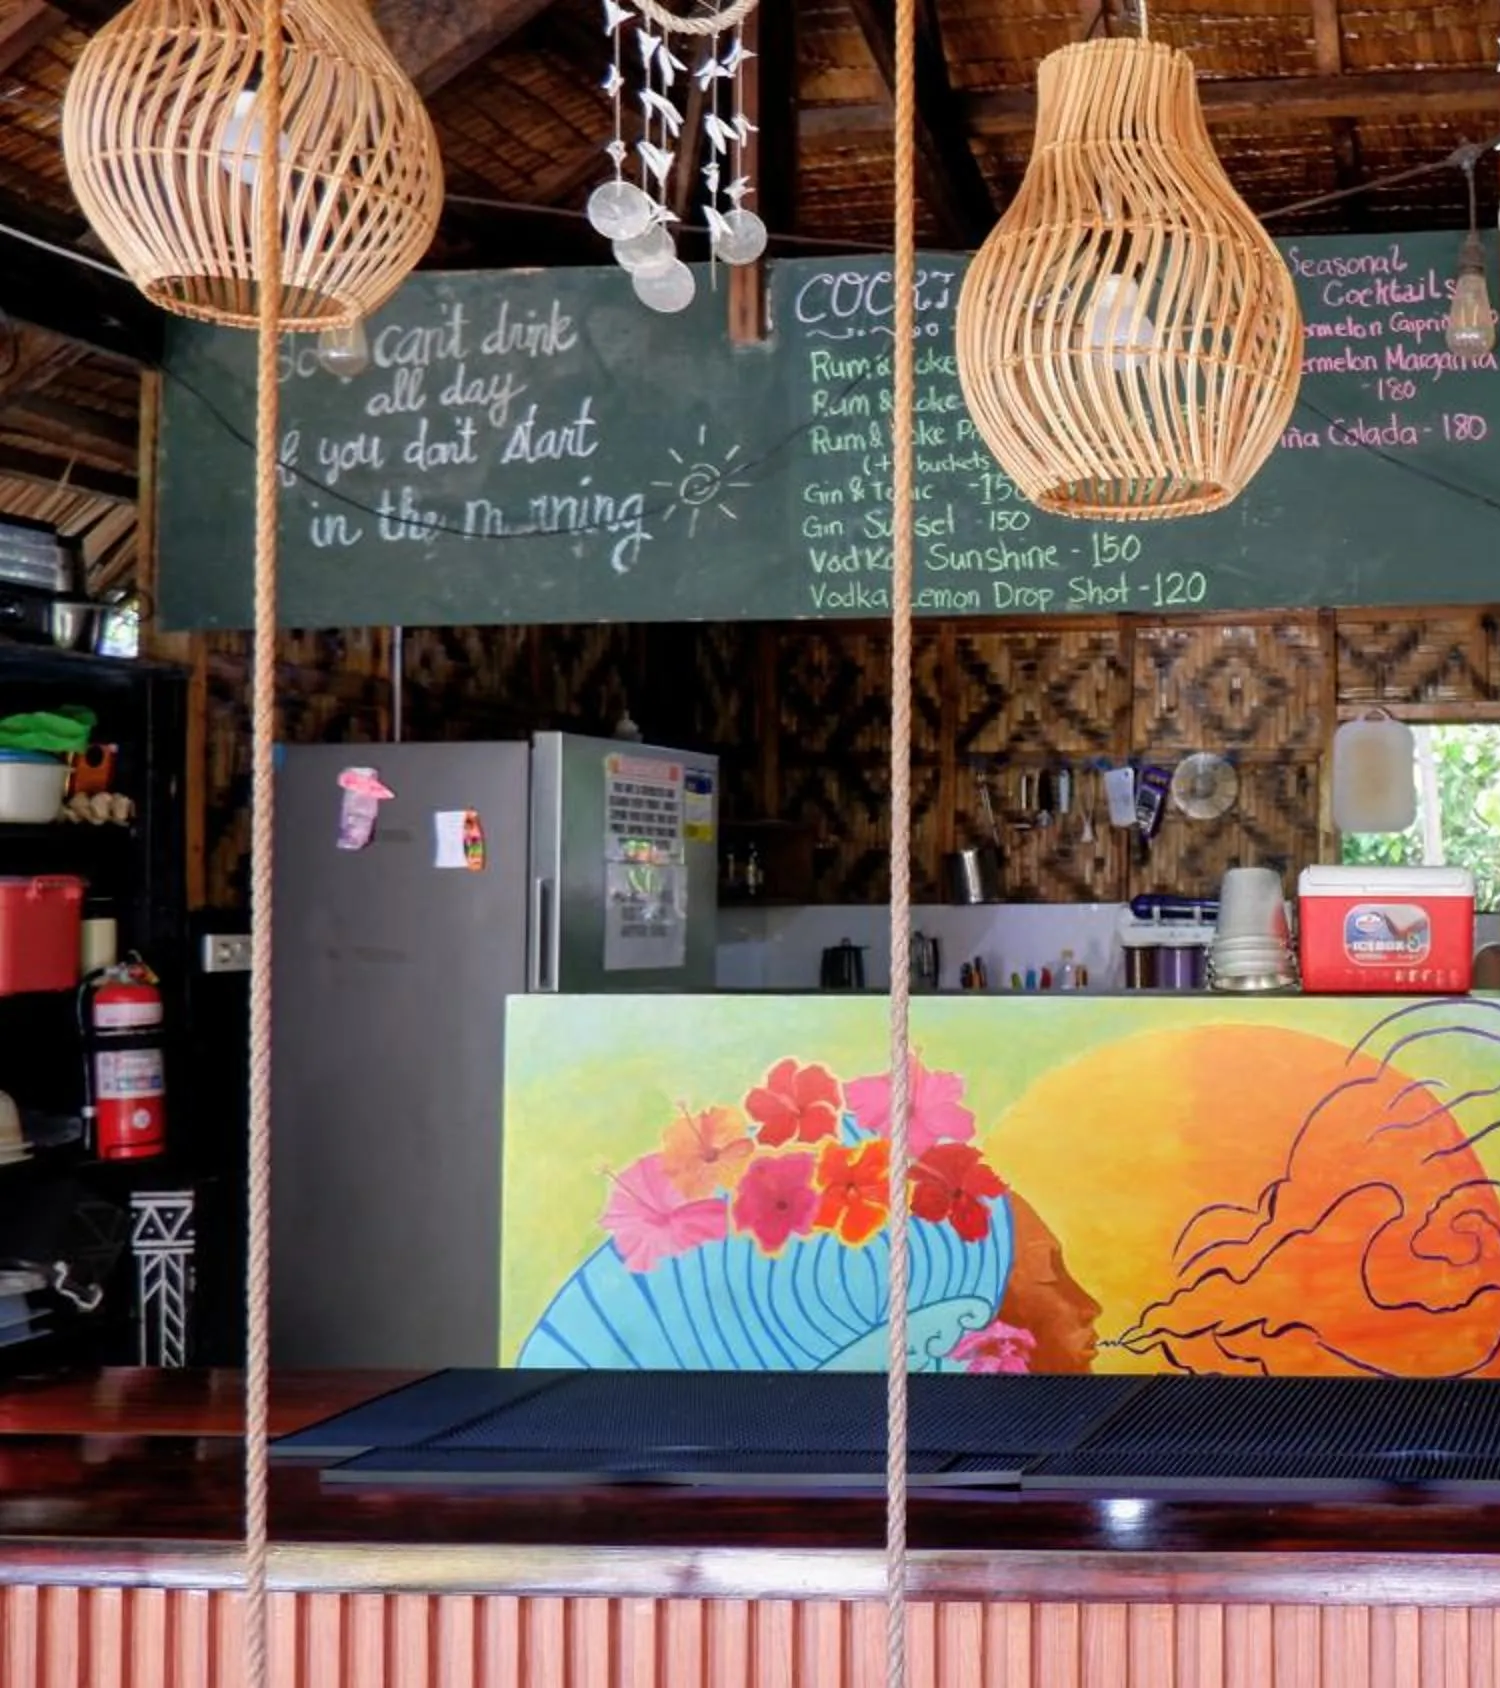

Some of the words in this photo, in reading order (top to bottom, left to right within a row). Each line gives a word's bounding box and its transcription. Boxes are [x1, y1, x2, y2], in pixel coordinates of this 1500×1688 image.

[1289, 245, 1408, 278] Seasonal
[1323, 270, 1458, 307] Cocktails
[481, 299, 580, 358] drink
[810, 350, 871, 383] Rum
[914, 350, 957, 377] oke
[365, 366, 427, 417] all
[439, 362, 528, 428] day
[811, 389, 870, 418] Rum
[911, 386, 958, 414] oke
[1377, 377, 1417, 401] 180
[318, 430, 386, 486] you
[500, 397, 600, 465] start
[810, 424, 867, 455] Rum
[1281, 426, 1321, 449] iña
[1327, 413, 1418, 447] Colada
[1442, 412, 1488, 441] 180
[916, 450, 991, 473] buckets
[803, 482, 844, 506] Gin
[310, 501, 363, 547] in
[802, 515, 844, 538] Gin
[989, 511, 1031, 532] 150
[924, 539, 1060, 573] Sunshine
[1091, 531, 1142, 568] 150
[911, 588, 981, 609] emon
[992, 581, 1055, 613] Drop
[1068, 571, 1132, 604] Shot
